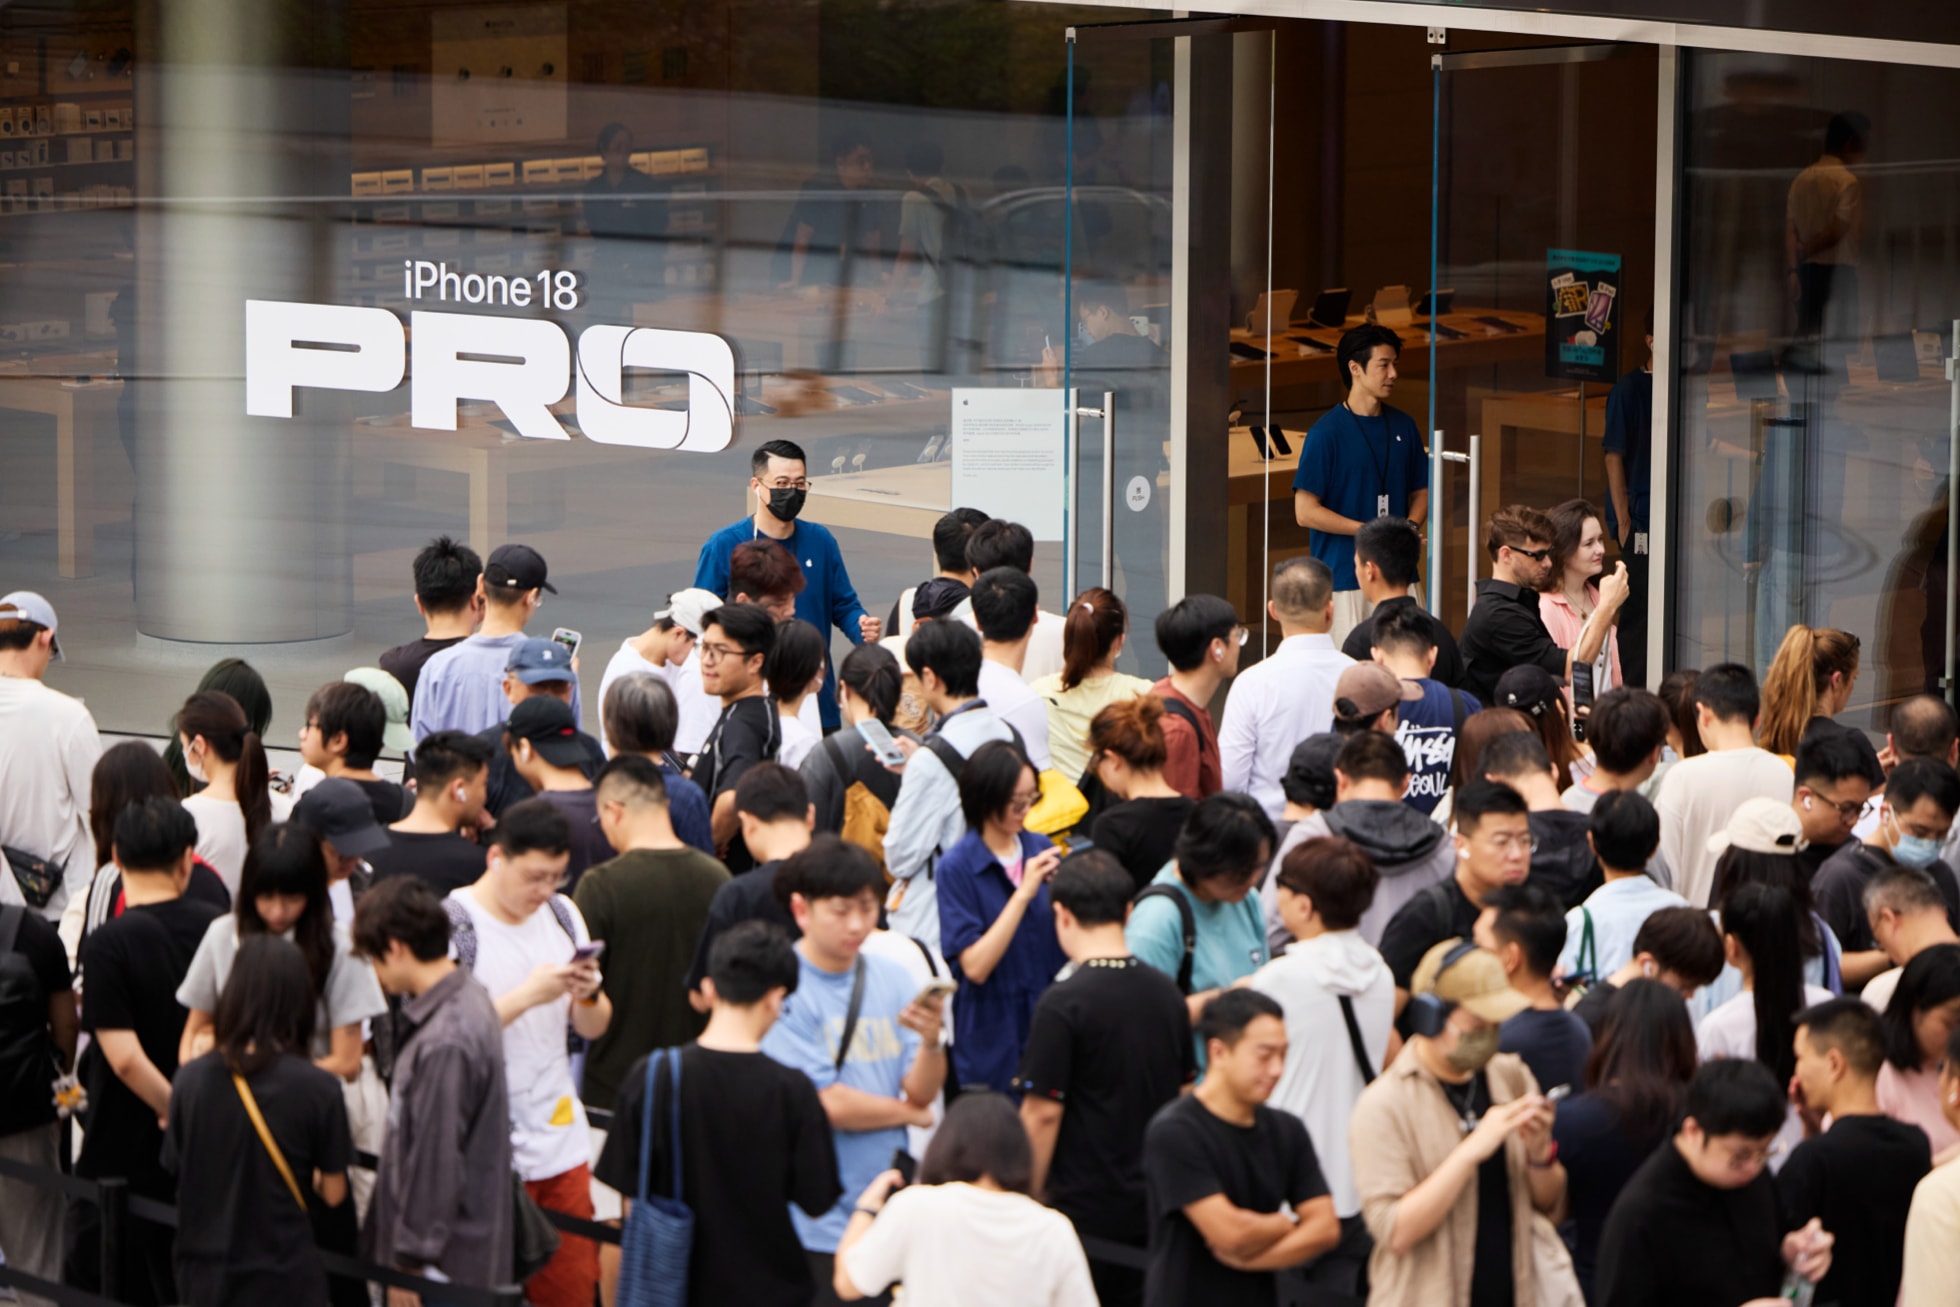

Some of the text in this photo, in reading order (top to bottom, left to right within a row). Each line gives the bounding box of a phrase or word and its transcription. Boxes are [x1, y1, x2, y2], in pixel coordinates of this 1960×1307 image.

[404, 259, 579, 312] iPhone 18
[245, 299, 736, 453] PRO
